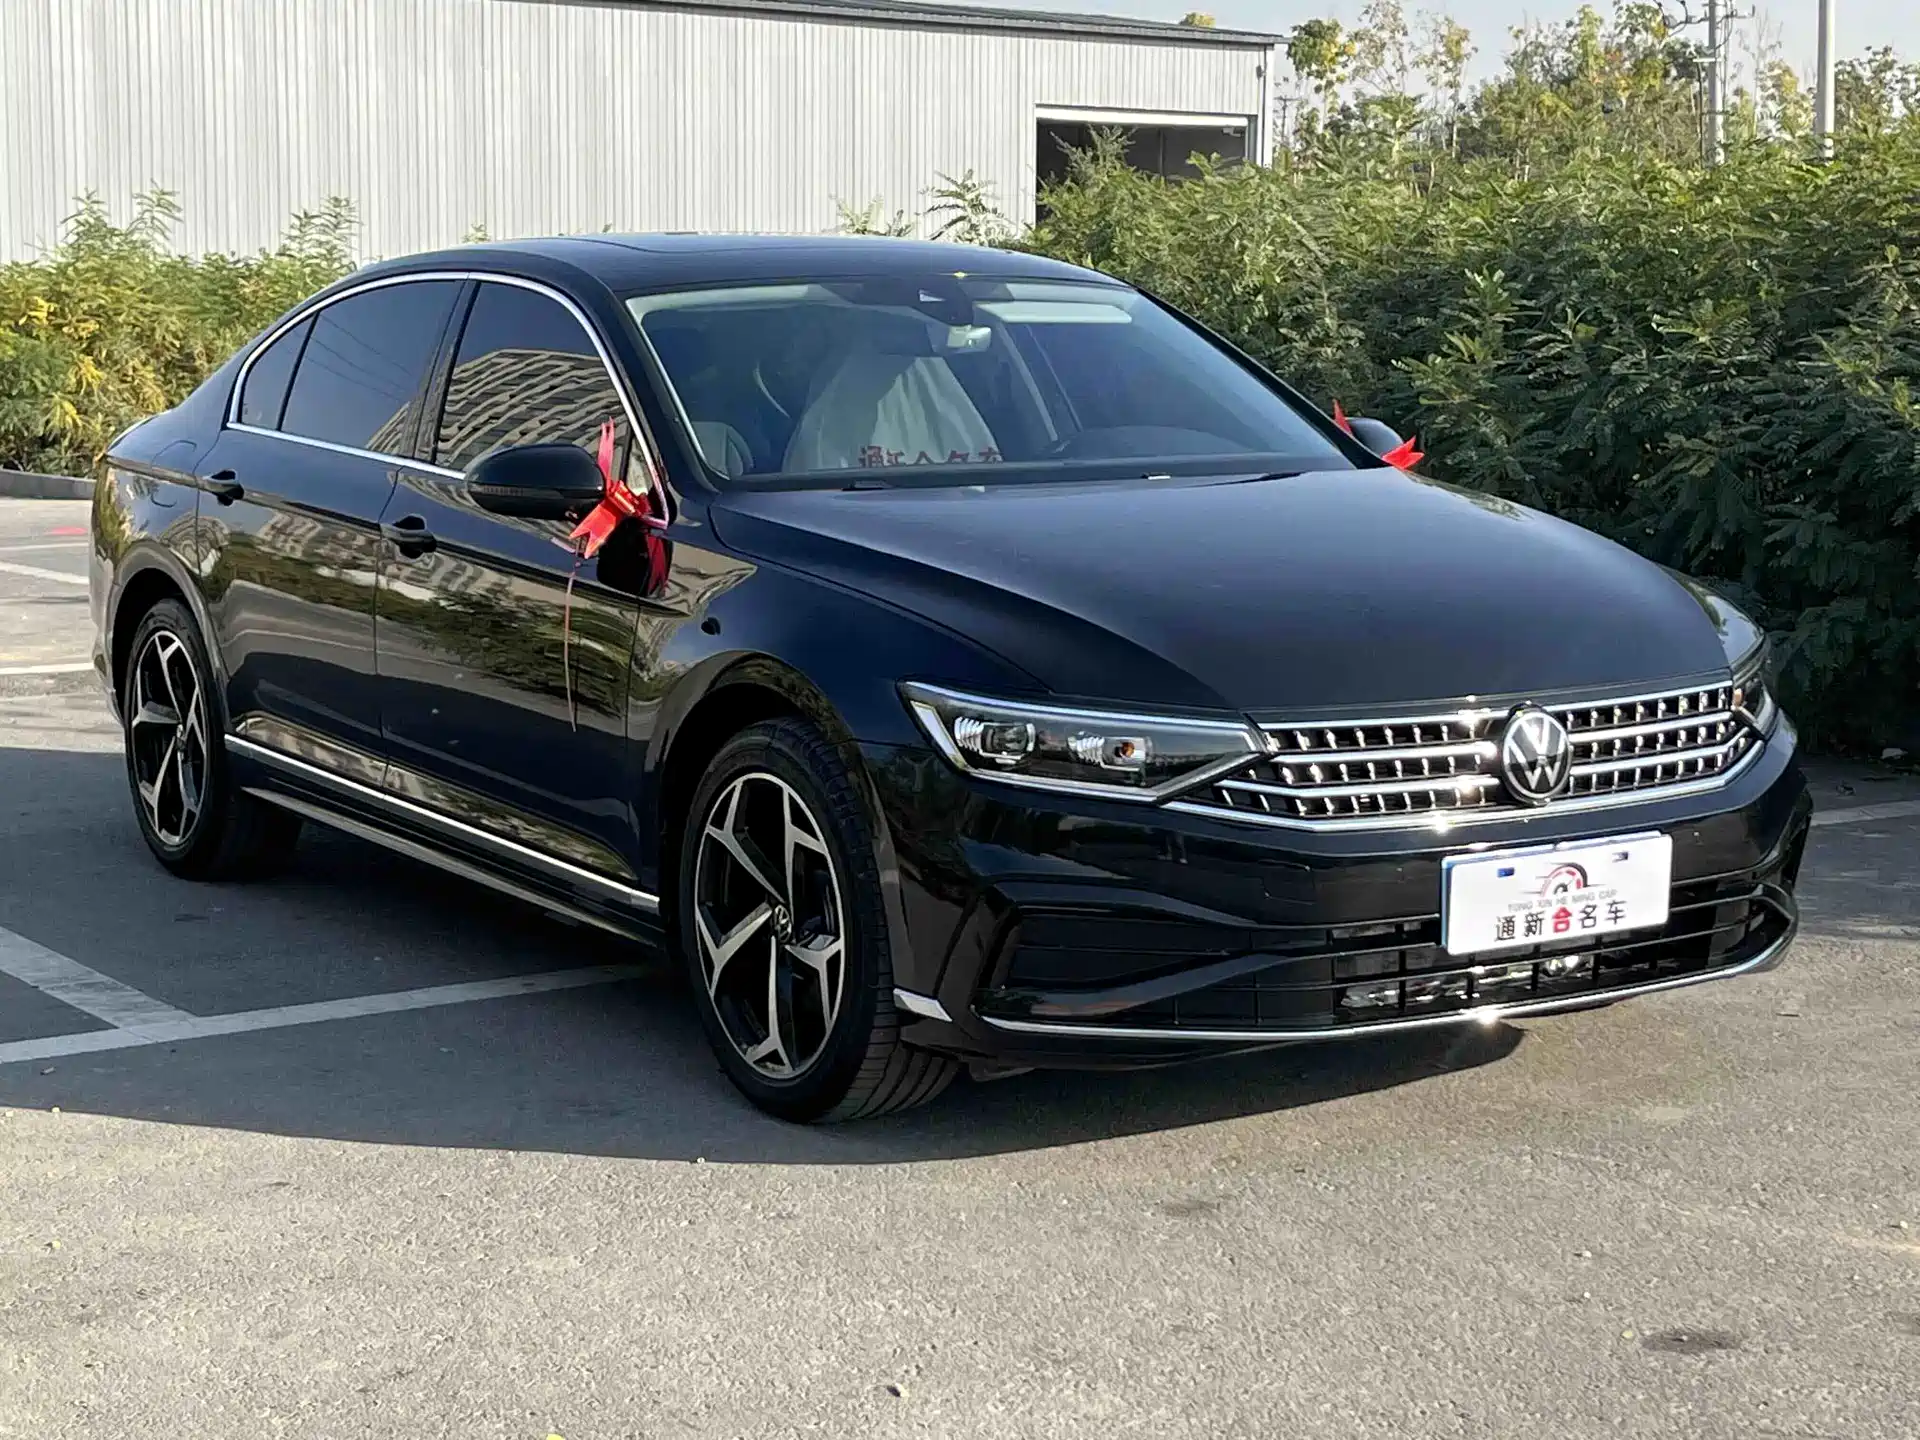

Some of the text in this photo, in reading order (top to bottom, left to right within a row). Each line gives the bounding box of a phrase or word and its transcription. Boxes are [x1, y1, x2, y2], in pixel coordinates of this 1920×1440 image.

[1493, 899, 1627, 942] 通新合名车
